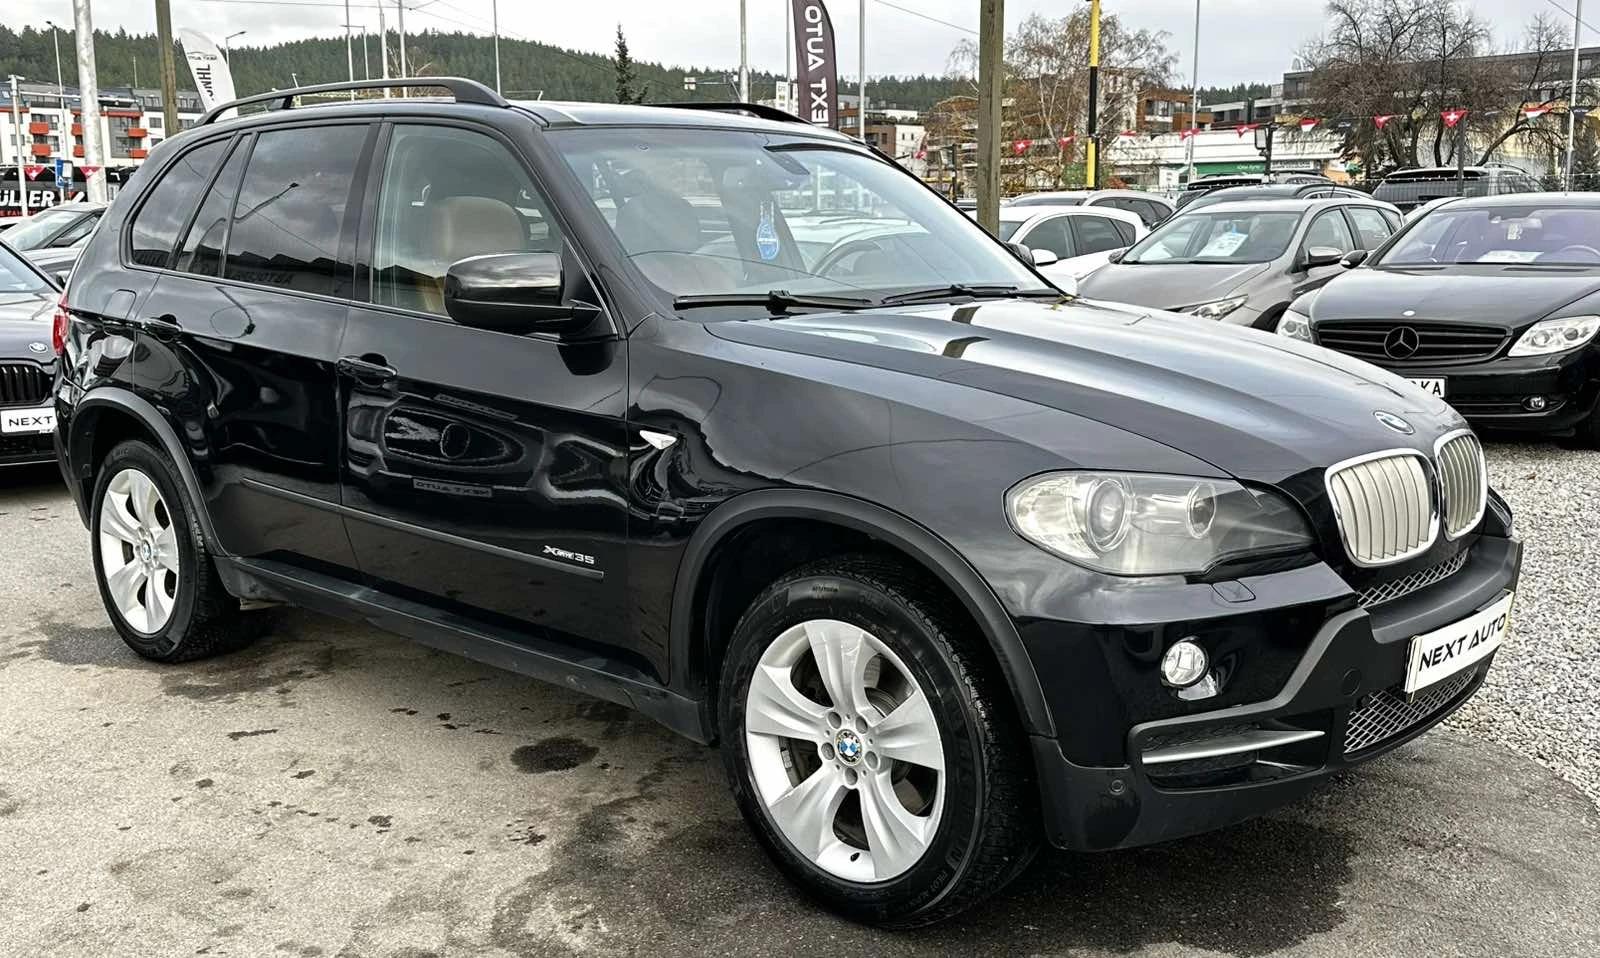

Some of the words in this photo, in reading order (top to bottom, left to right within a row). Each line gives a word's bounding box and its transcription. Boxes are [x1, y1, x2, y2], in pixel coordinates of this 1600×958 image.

[8, 415, 53, 427] NEXT
[1419, 634, 1468, 672] NEXT
[1468, 612, 1507, 651] AUTO
